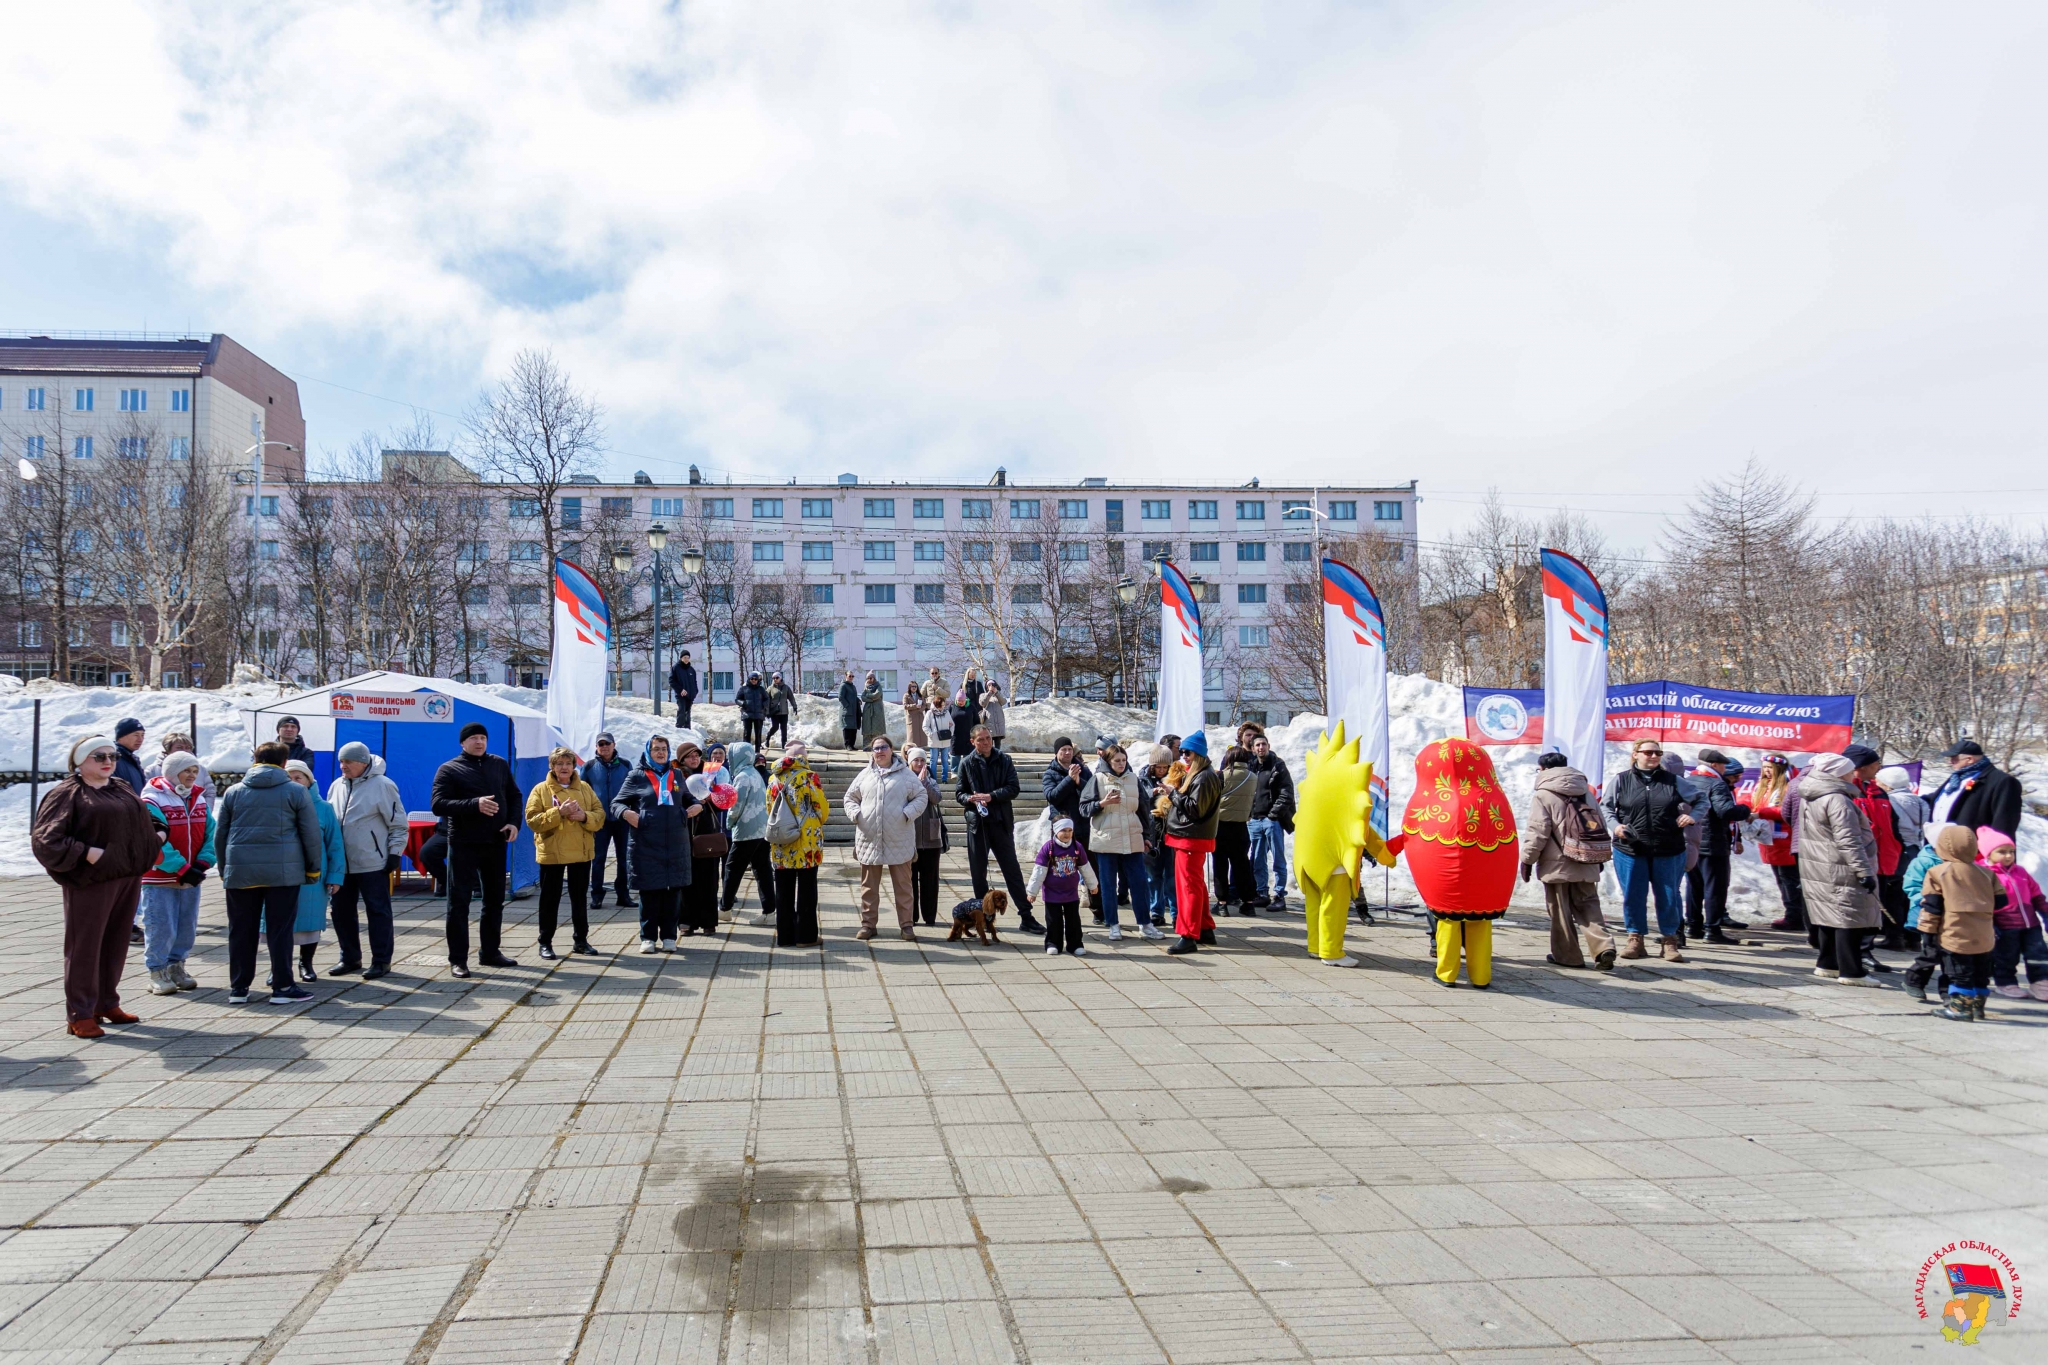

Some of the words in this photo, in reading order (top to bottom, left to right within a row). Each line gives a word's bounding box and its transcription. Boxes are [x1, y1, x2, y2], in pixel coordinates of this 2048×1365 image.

[356, 695, 384, 705] НАПИШИ
[386, 697, 416, 706] ПИСЬМО
[1682, 694, 1776, 714] областной
[1775, 706, 1821, 718] союз
[368, 706, 400, 716] СОЛДАТУ
[1604, 714, 1681, 730] анизаций
[1686, 718, 1802, 739] профсоюзов!
